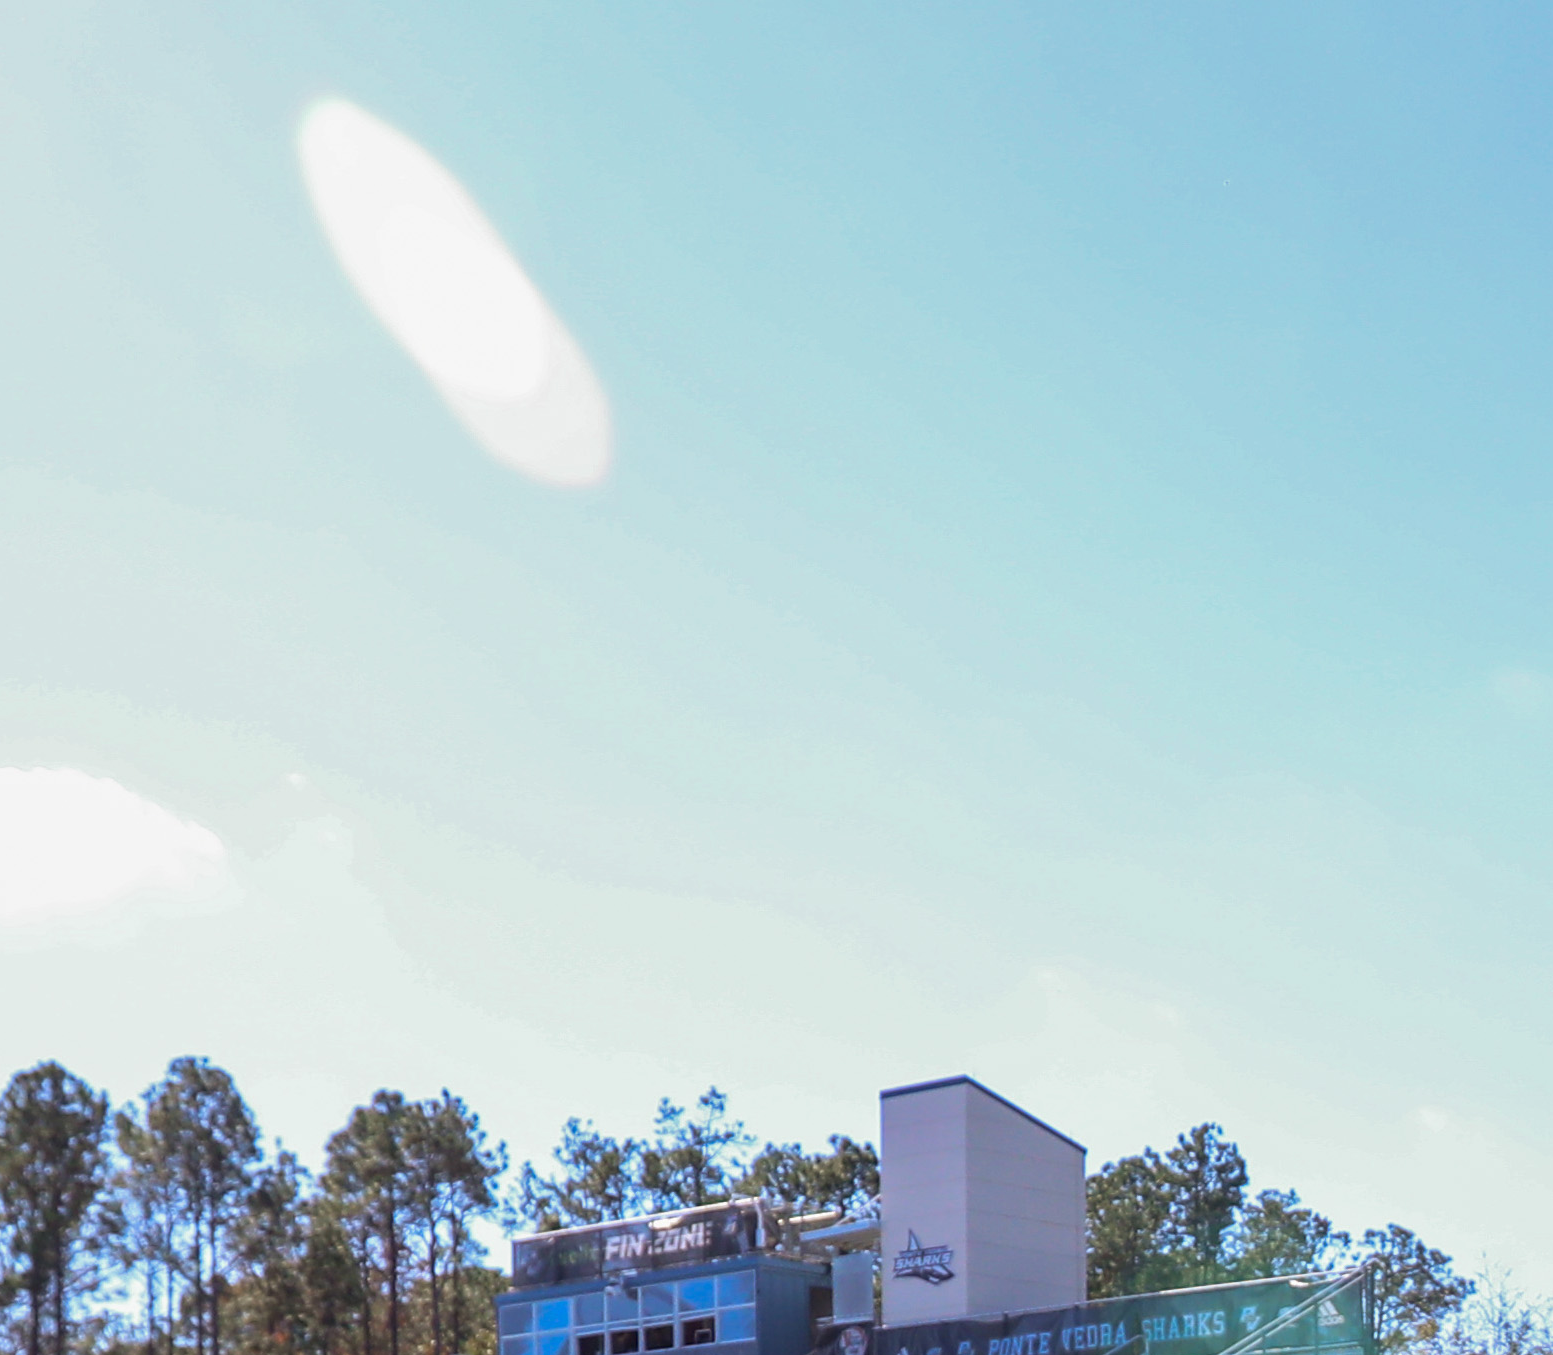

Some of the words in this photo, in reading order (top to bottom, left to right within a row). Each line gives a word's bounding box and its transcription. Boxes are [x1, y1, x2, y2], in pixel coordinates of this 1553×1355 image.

[604, 1232, 645, 1261] FIN
[894, 1252, 951, 1269] SHARKS
[1061, 1321, 1127, 1350] VEDRA
[1142, 1310, 1226, 1342] SHARKS
